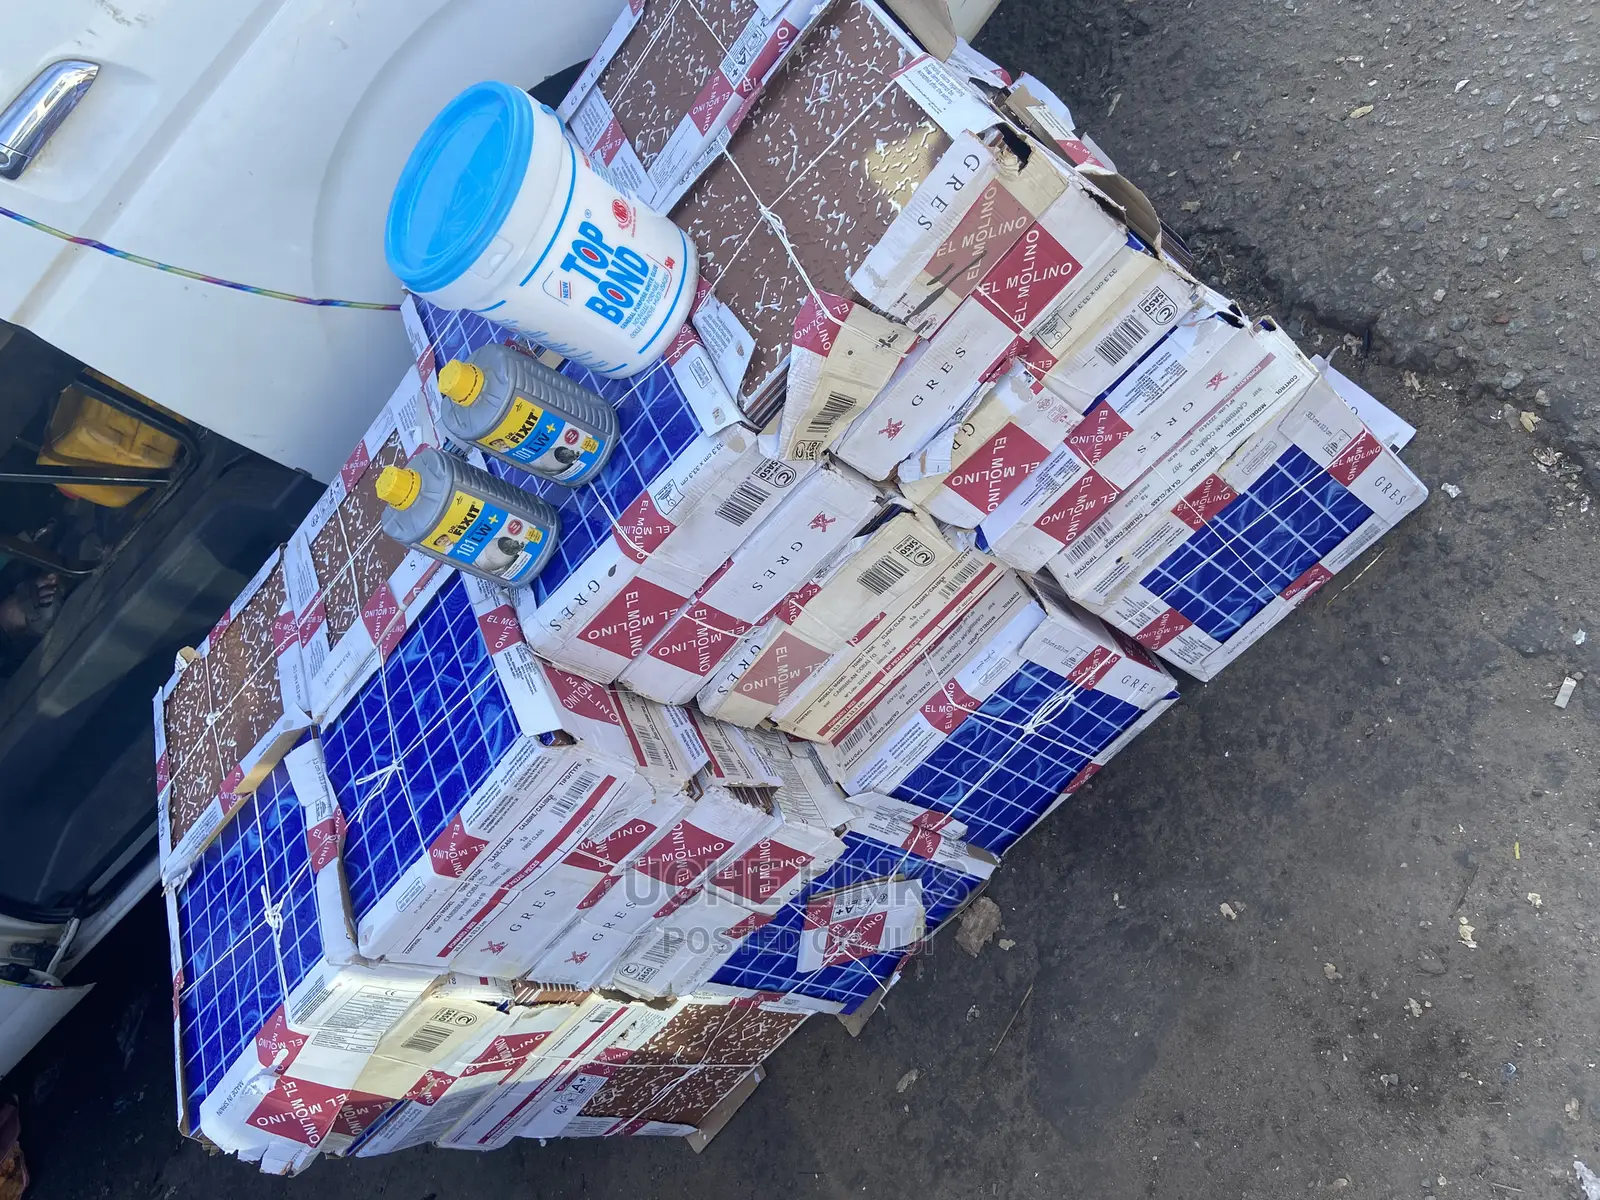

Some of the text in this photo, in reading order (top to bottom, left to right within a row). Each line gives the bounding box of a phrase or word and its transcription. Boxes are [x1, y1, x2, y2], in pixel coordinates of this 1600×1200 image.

[917, 153, 980, 231] GRES
[936, 216, 1027, 258] EL MOLINO
[966, 186, 997, 281] EL MOLINO
[560, 220, 609, 283] TOP
[562, 281, 570, 299] NEW
[585, 246, 649, 325] BOND
[1005, 261, 1073, 290] MOLINO
[1013, 229, 1040, 324] EL MOLINO
[1142, 291, 1164, 313] SASO
[912, 347, 966, 407] GRES
[1273, 373, 1298, 396] CONTROL
[509, 411, 539, 446] FIXIT
[1070, 434, 1112, 444] MOLINO
[1091, 409, 1108, 465] EL MOLINO
[1135, 400, 1195, 455] GRES
[511, 442, 535, 465] 101
[1170, 461, 1183, 474] 207
[1347, 446, 1381, 464] MOLINO
[758, 459, 778, 479] SASO
[951, 464, 1016, 486] MOLINO
[986, 436, 1007, 512] EL MOLINO
[1374, 476, 1407, 506] GRES
[452, 504, 480, 538] FIXIT
[1040, 501, 1095, 526] MOLINO
[1065, 475, 1093, 541] EL MOLINO
[455, 535, 478, 560] 101
[899, 537, 918, 557] SASO
[752, 541, 803, 591] GRES
[1072, 553, 1097, 577] TIPO/TYPE
[486, 614, 498, 624] EL
[550, 580, 600, 631] GRES
[588, 614, 655, 640] MOLINO
[625, 591, 643, 658] EL MOLINO
[658, 632, 722, 657] MOLINO
[694, 608, 711, 672] EL MOLINO
[563, 681, 594, 709] MOLINO
[742, 669, 800, 692] MOLINO
[777, 662, 790, 704] MOLINO
[565, 676, 619, 722] MOLINO
[558, 761, 583, 787] TIPO/TYPE
[580, 824, 647, 850] MLINO
[672, 822, 688, 869] MOLINO
[637, 842, 725, 867] EL MOLINO
[723, 855, 807, 880] EL MOLINO
[759, 837, 771, 894] EL MOLINO
[510, 889, 556, 933] GRES
[592, 900, 637, 942] GRES
[637, 965, 654, 982] SASO
[256, 1103, 323, 1127] MOLINO
[290, 1098, 320, 1144] MOLINO
